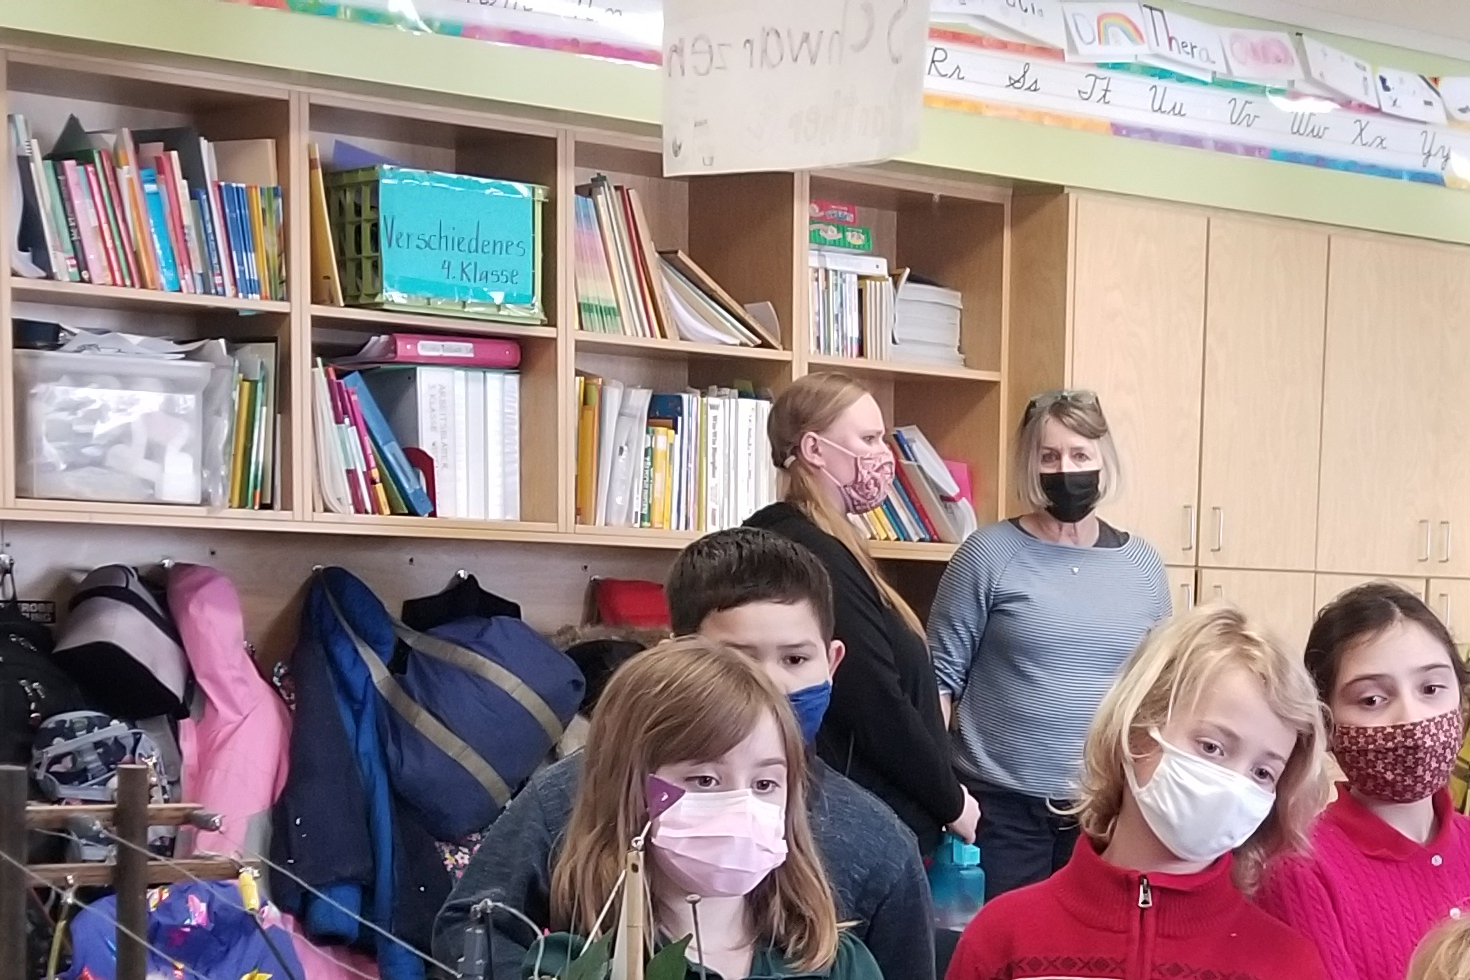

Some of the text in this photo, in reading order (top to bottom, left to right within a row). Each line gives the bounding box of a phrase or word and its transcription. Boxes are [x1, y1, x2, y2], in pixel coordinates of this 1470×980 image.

[928, 47, 965, 80] Rr
[1005, 63, 1040, 93] Ss
[1078, 73, 1111, 105] Tt
[1149, 85, 1187, 117] Uu
[1228, 97, 1260, 127] Vv
[1291, 112, 1330, 139] Ww
[1353, 119, 1388, 149] Xx
[1421, 130, 1451, 170] Yy
[383, 214, 526, 257] Verschiedenes
[441, 259, 519, 285] 4. Klasse
